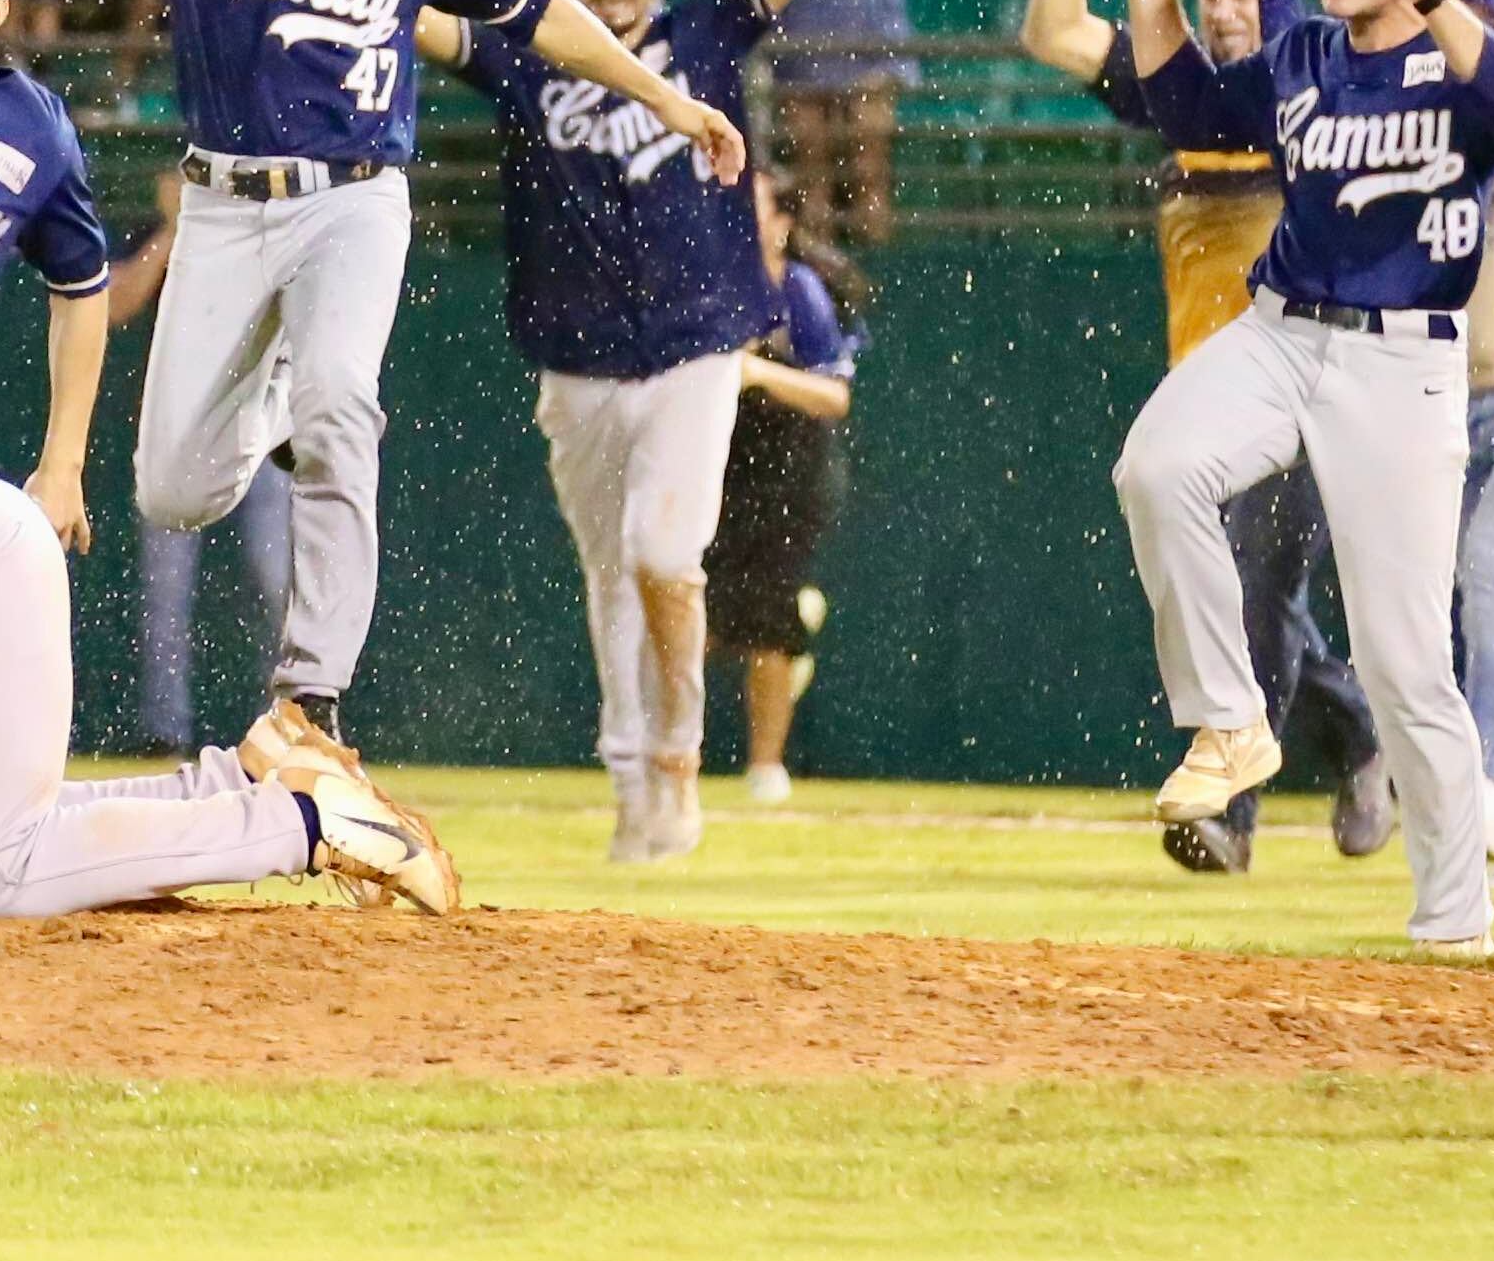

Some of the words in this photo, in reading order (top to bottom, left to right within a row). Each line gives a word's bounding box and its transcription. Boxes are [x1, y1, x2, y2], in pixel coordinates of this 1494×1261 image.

[343, 46, 399, 112] 47
[1276, 85, 1466, 218] Camuy
[1416, 197, 1481, 263] 48
